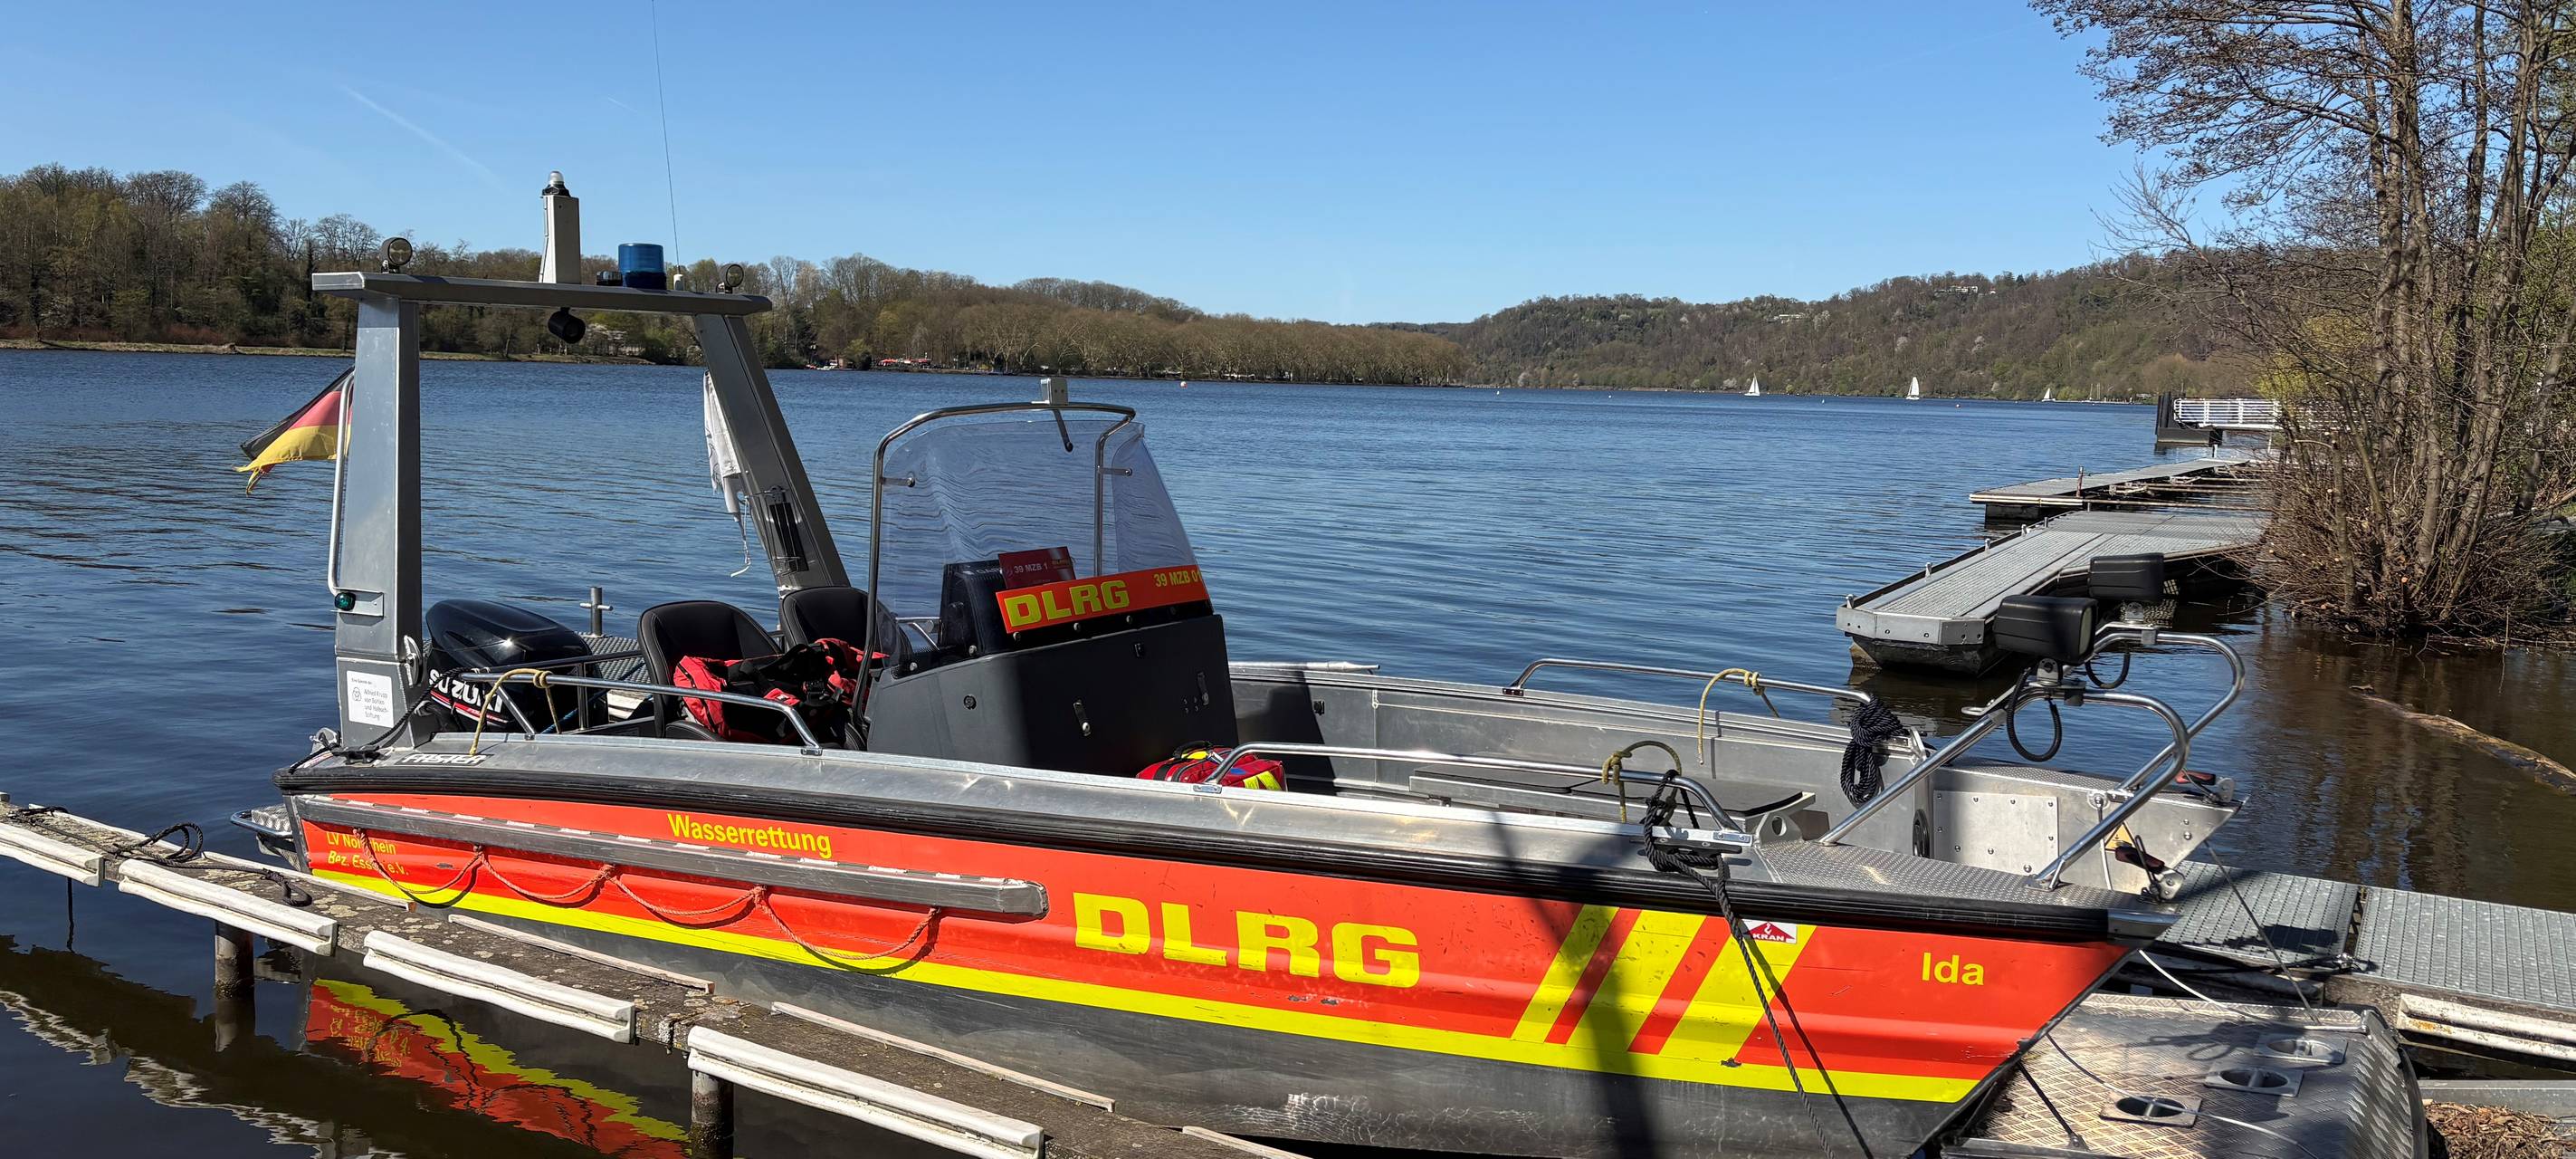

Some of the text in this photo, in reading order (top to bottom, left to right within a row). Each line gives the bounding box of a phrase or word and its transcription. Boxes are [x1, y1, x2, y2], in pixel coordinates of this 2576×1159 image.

[1153, 573, 1168, 588] 39
[1169, 570, 1190, 586] MZB
[1004, 580, 1130, 627] DLRG
[327, 832, 396, 855] LV Norhein
[667, 813, 832, 858] Wasserrettung
[328, 850, 349, 867] Bez.
[387, 861, 409, 876] e.V.
[1073, 892, 1420, 988] DLRG
[1752, 933, 1785, 942] KRAN
[1922, 952, 1984, 985] Ida
